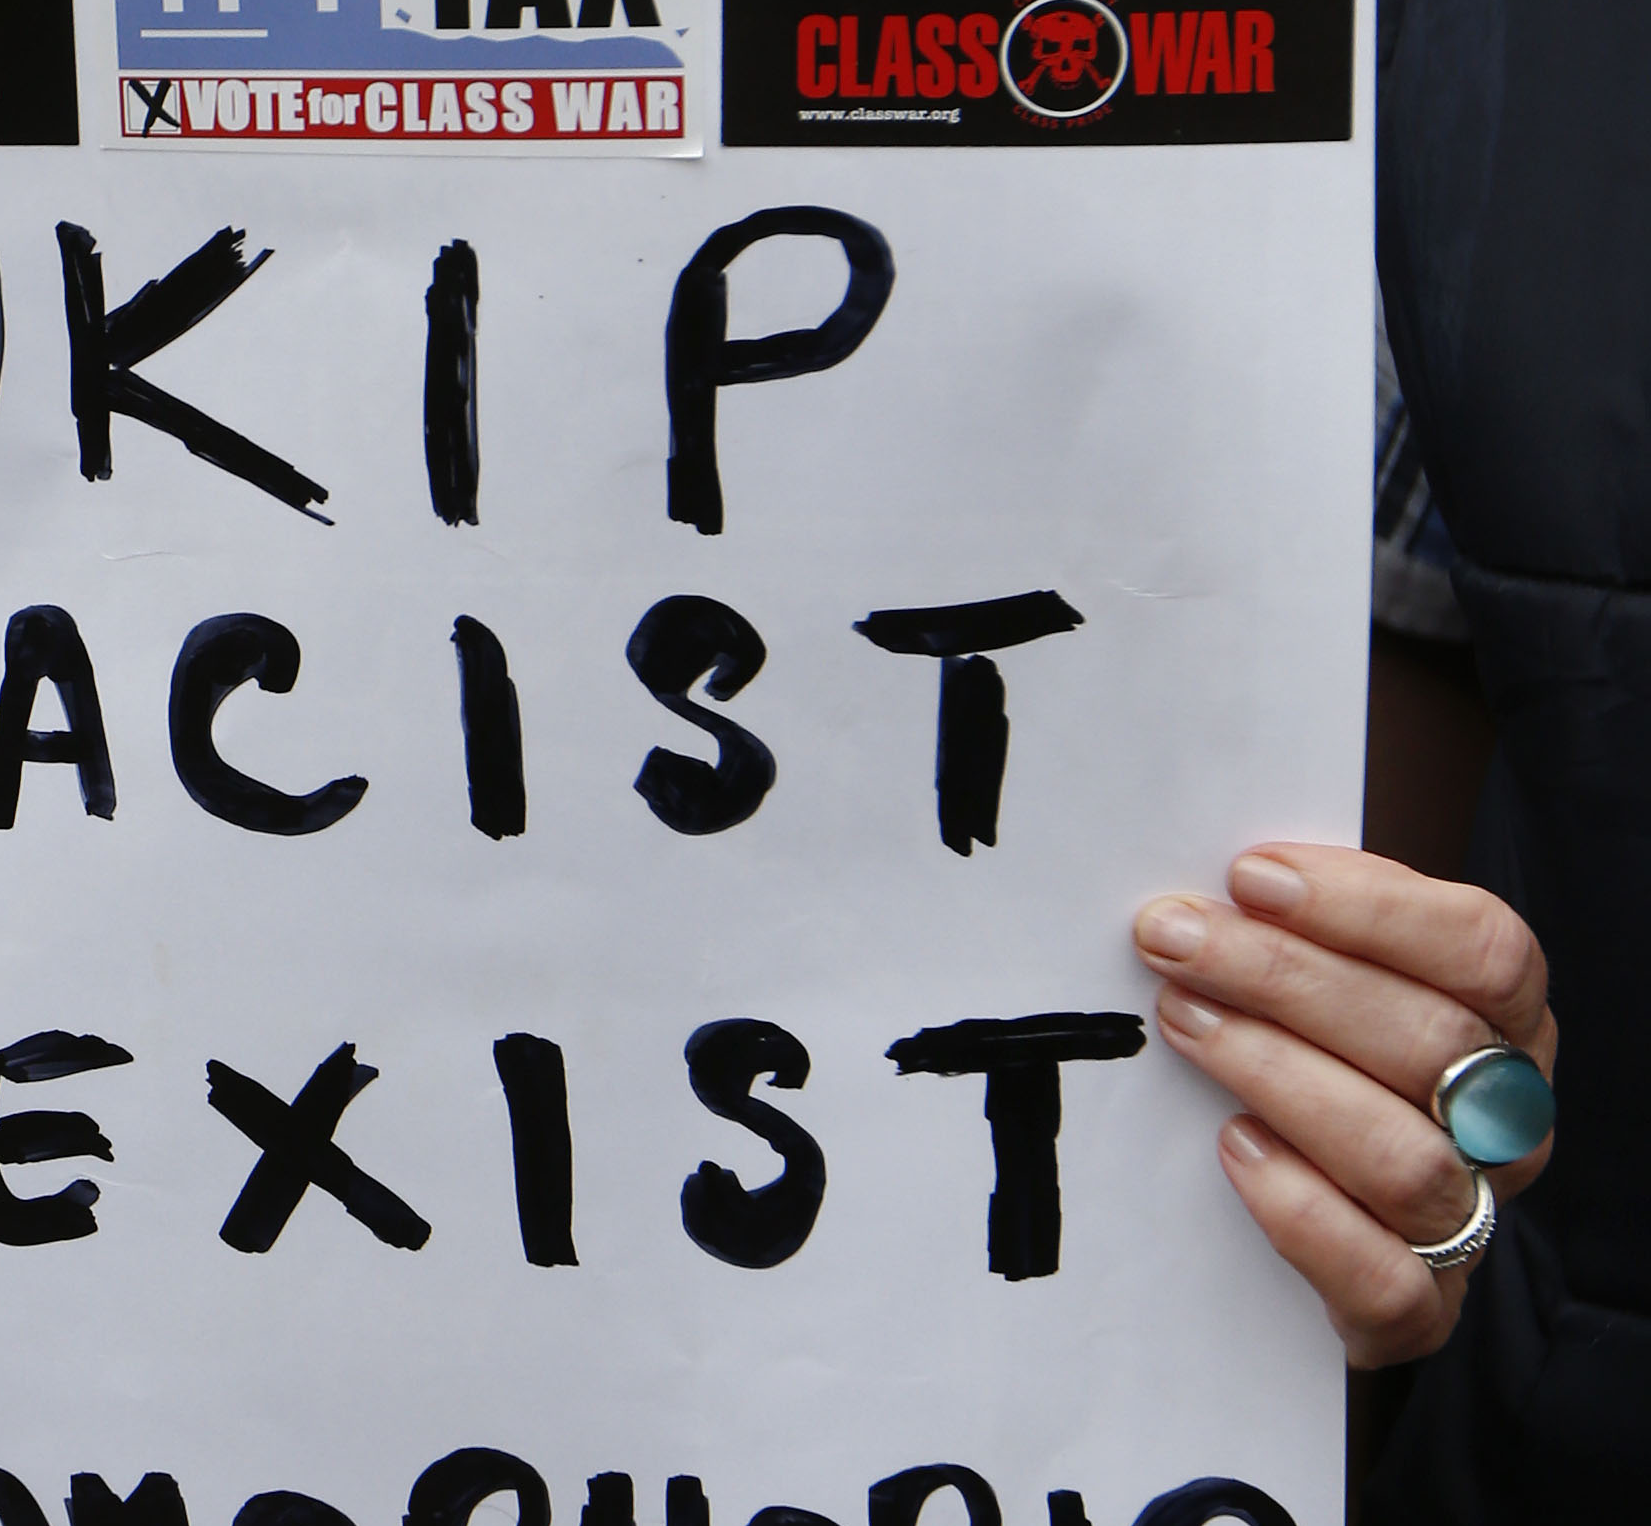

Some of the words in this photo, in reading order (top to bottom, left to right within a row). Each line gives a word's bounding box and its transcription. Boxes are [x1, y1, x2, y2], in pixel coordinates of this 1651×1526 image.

[796, 13, 1000, 100] CLASS
[1129, 10, 1276, 96] WAR
[182, 80, 305, 132] VOTE
[307, 88, 361, 126] for
[364, 81, 536, 133] CLASS
[551, 81, 681, 132] WAR
[799, 107, 961, 123] www.classwar.org
